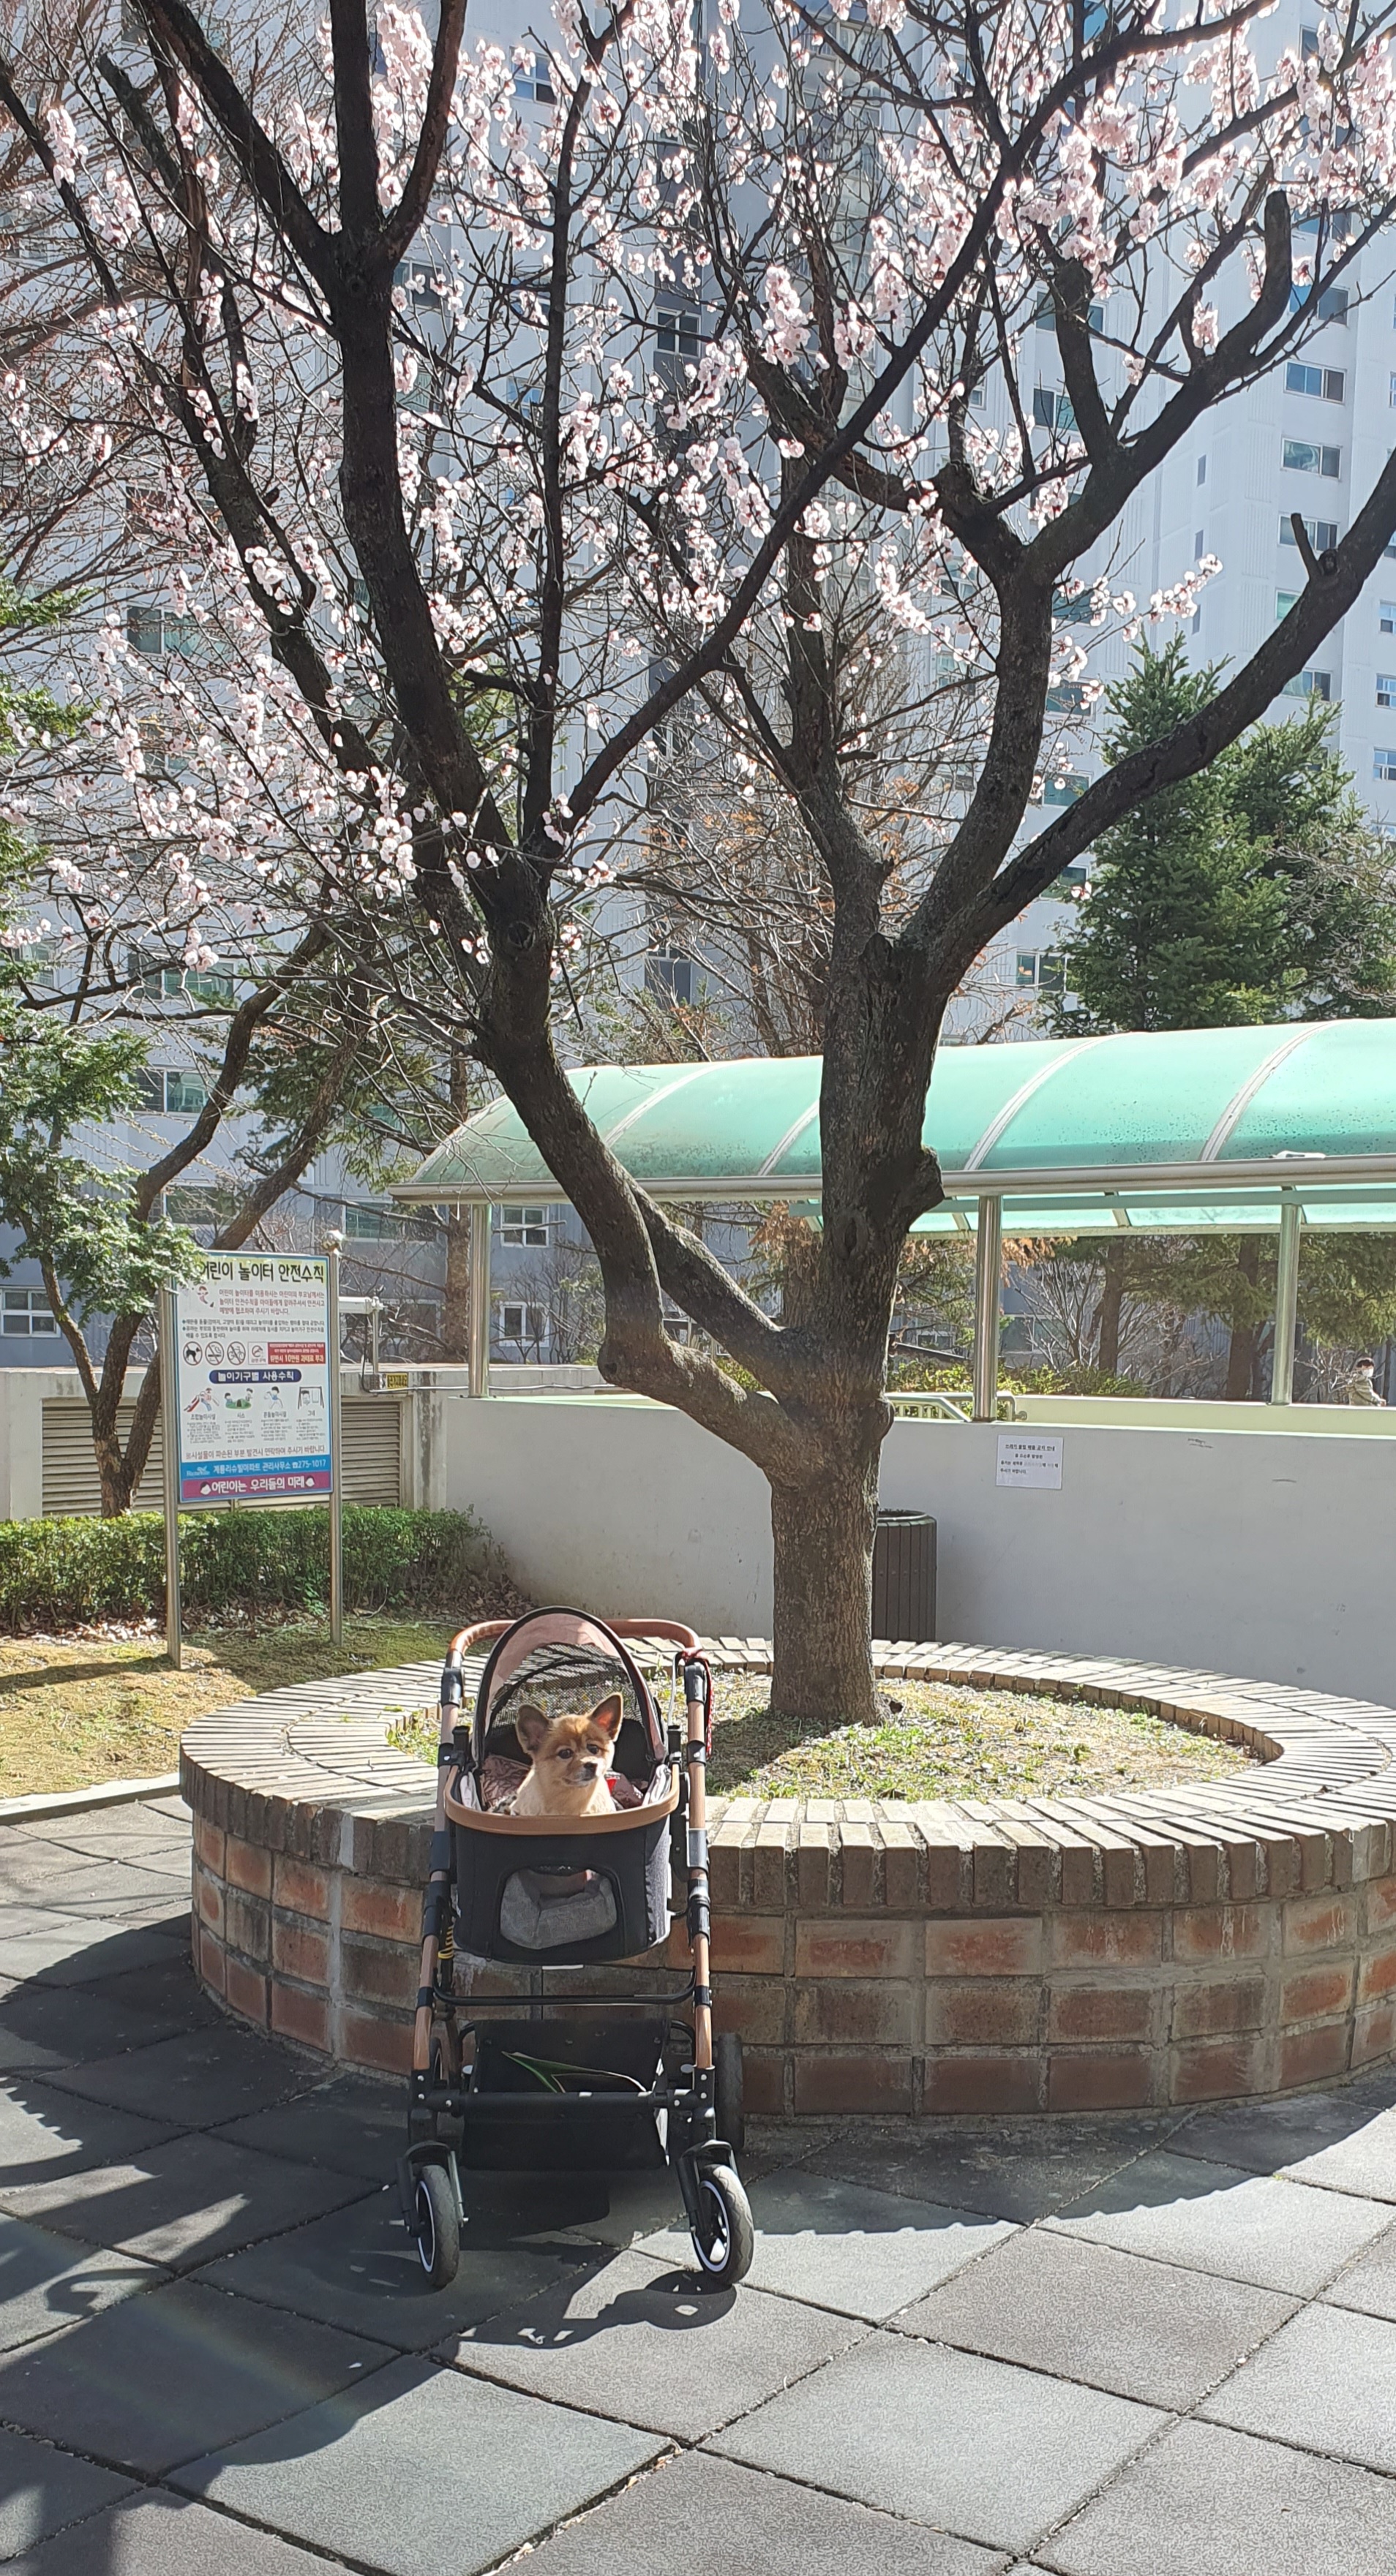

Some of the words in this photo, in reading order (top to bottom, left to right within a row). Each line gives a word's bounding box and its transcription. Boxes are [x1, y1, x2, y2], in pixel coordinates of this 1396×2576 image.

[238, 1262, 274, 1281] 놀이터
[279, 1264, 323, 1283] 안전수칙
[219, 1289, 233, 1297] 어린이
[255, 1289, 277, 1298] 이용하시는
[279, 1290, 297, 1298] 어린이의
[307, 1300, 325, 1308] 안전사고
[285, 1355, 300, 1363] 10만원
[262, 1371, 294, 1381] 사용수칙
[215, 1450, 233, 1458] 파손된
[265, 1447, 286, 1456] 연락하여
[287, 1445, 303, 1454] 주시기
[262, 1462, 291, 1472] 관리사무소
[211, 1480, 247, 1494] 어린이는
[249, 1477, 285, 1491] 우리들의
[288, 1476, 305, 1489] 미래
